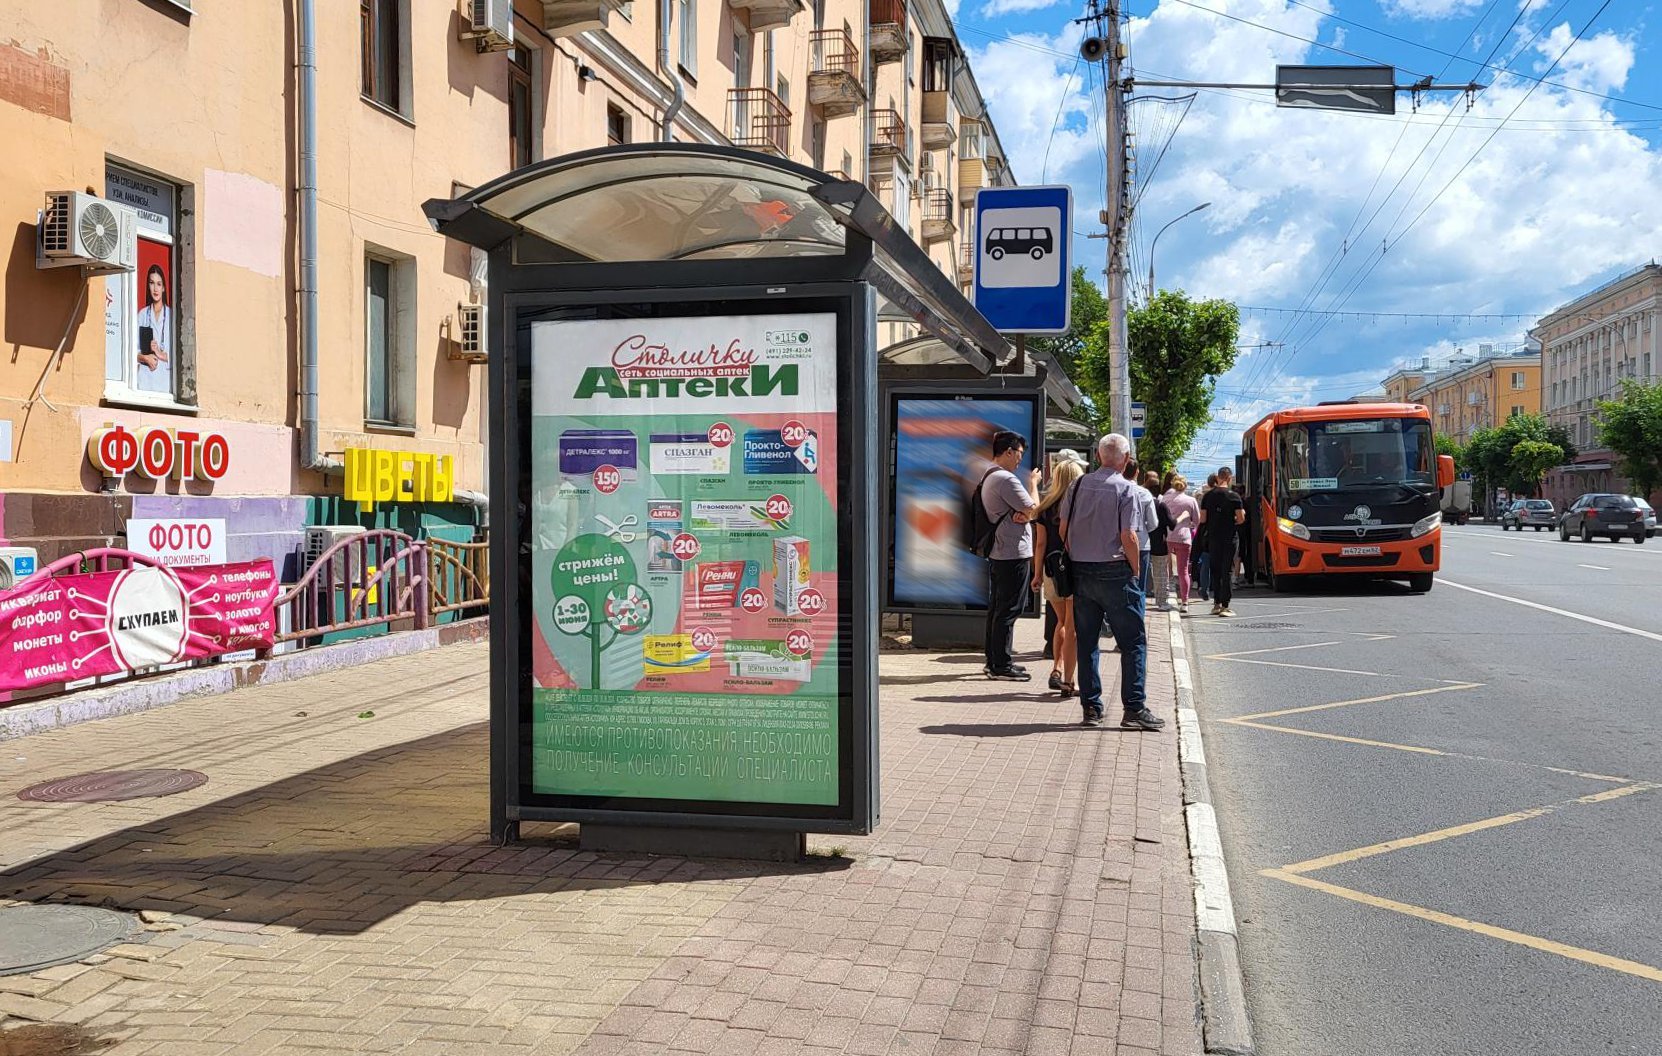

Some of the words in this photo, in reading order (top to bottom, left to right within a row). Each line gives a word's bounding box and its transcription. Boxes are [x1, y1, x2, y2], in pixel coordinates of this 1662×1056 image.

[611, 334, 760, 368] Столички
[620, 369, 642, 378] сеть
[645, 369, 713, 378] социальных
[717, 368, 750, 377] аптек
[100, 425, 230, 480] ФОТО
[664, 448, 712, 457] СПАЗГАН
[744, 440, 785, 452] Прокто-
[744, 450, 791, 459] Гливенол
[346, 448, 453, 512] ЦВЕТЫ
[652, 510, 678, 518] ARTRA
[148, 523, 212, 551] ФОТО
[163, 554, 211, 566] ДОКУМЕНТЫ
[558, 553, 625, 573] стрижём
[222, 569, 271, 582] телефоны
[573, 568, 619, 586] цены!
[705, 570, 737, 581] Ренни
[225, 589, 269, 603] ноутбуки
[225, 607, 261, 620] золото
[557, 602, 587, 615] 1-30
[11, 609, 62, 629] фарфор
[118, 609, 179, 631] СКУПАЕМ
[238, 620, 270, 633] многое
[13, 633, 63, 652] монеты
[24, 661, 67, 680] иконы
[546, 724, 604, 747] ИМЕЮТСЯ
[743, 731, 832, 756] НЕОБХОДИМО
[546, 749, 620, 774] ПОЛУЧЕНИЕ
[628, 753, 729, 780] КОНСУЛЬТАЦИИ
[736, 757, 831, 782] СПЕЦИАЛИСТА
